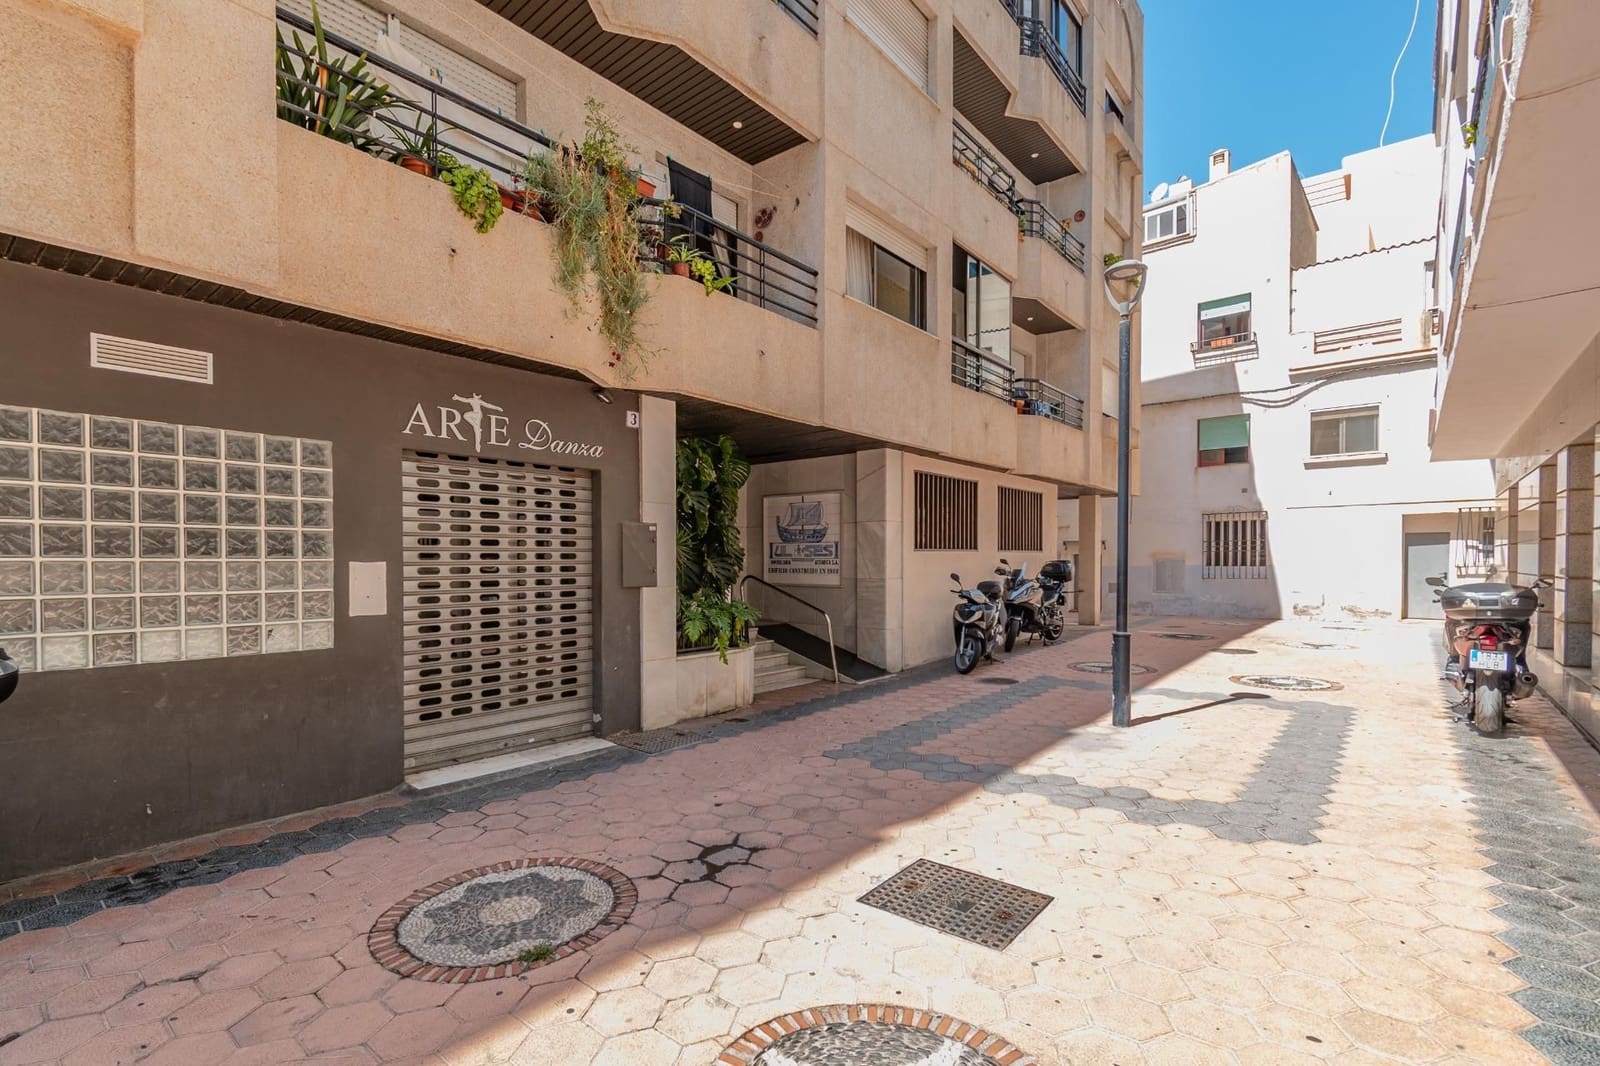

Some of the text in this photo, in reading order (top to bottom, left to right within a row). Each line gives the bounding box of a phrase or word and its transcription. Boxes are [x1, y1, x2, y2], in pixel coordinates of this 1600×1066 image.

[401, 392, 604, 458] ARTE Danza
[630, 412, 637, 426] 3
